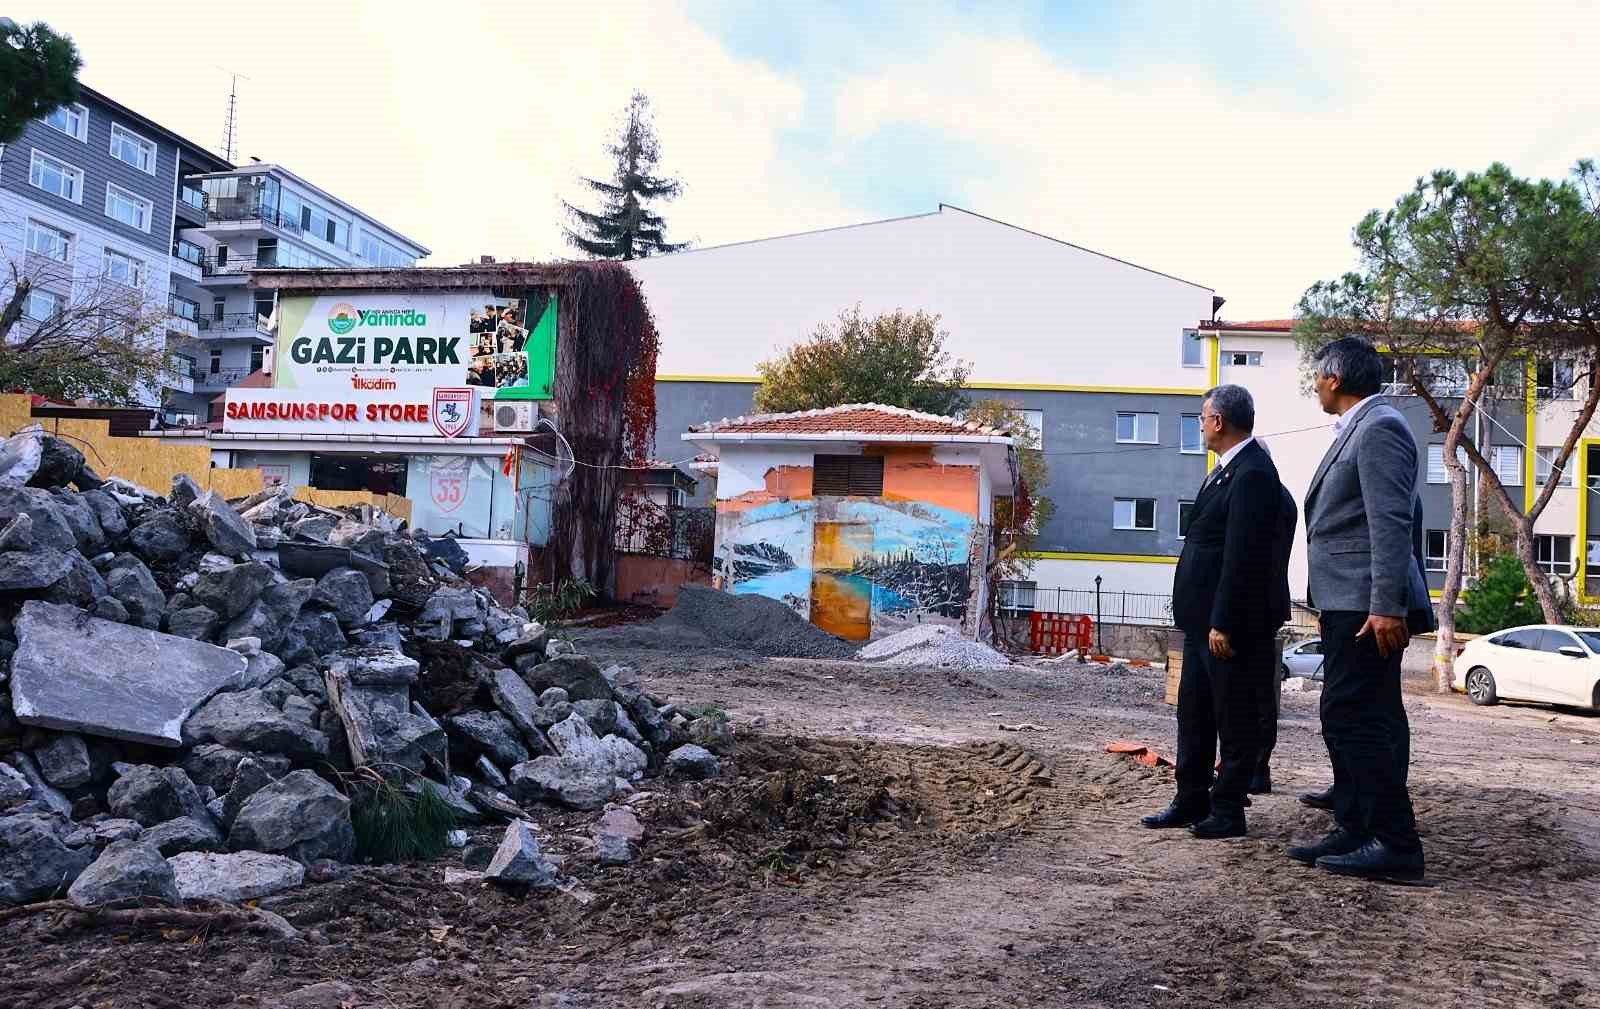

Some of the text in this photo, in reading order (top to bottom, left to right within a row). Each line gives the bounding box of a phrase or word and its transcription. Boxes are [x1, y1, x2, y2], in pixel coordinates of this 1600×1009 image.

[373, 337, 461, 365] PARK
[226, 402, 429, 422] SAMSUNSPOR STORE
[437, 479, 461, 503] 55
